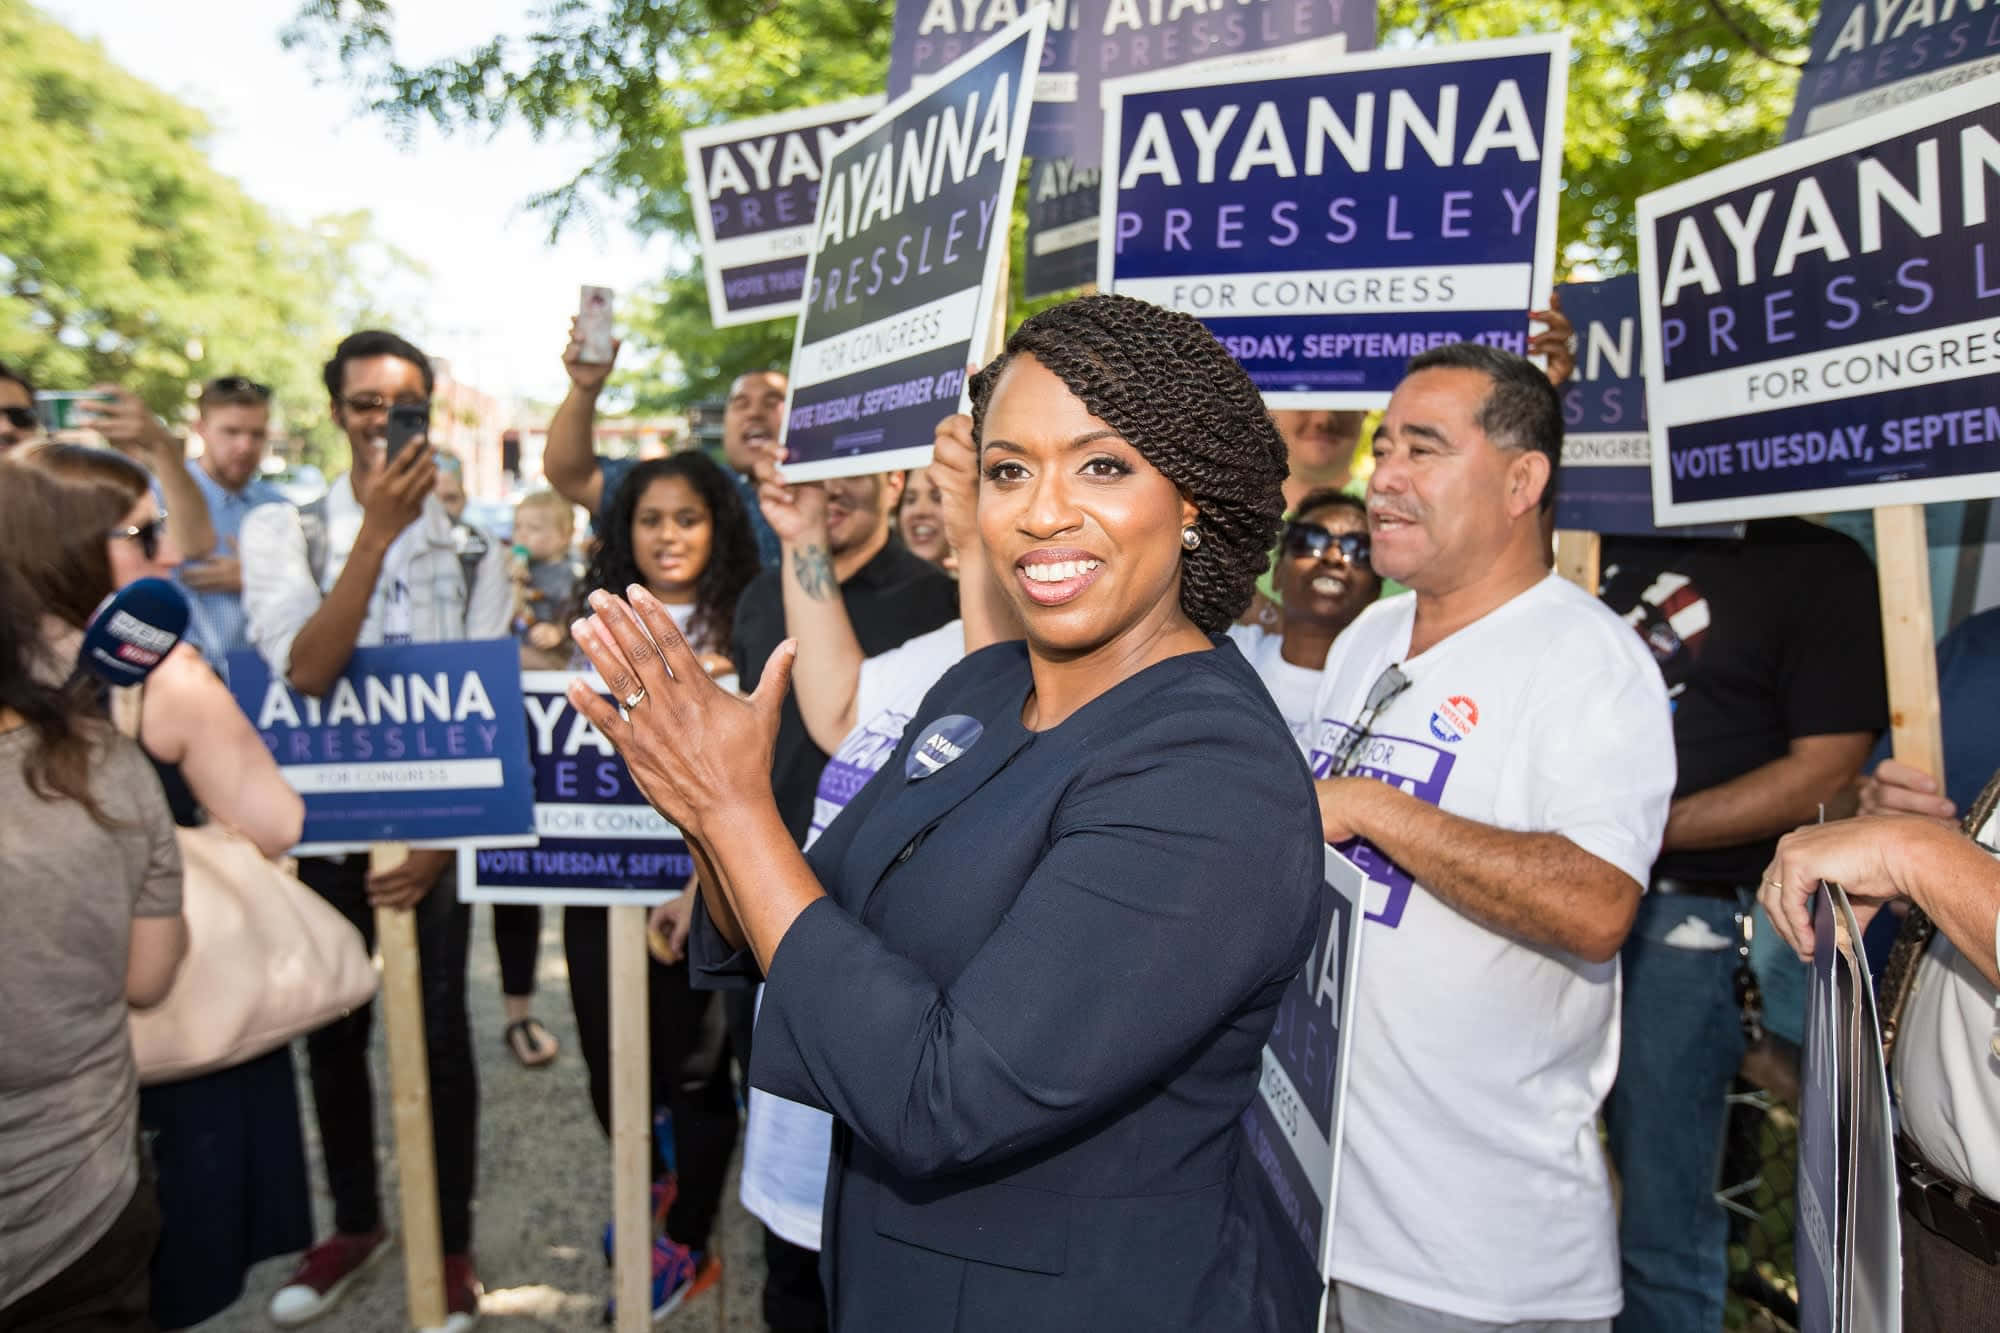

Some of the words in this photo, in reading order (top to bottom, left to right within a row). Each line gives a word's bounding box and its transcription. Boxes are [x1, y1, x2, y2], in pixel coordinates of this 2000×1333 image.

[1824, 0, 2000, 63] AYA
[1119, 79, 1541, 190] AYANNA
[815, 71, 1009, 255] AYANNA
[1114, 187, 1537, 255] PRESSLEY
[803, 193, 999, 314] PRESSLEY
[725, 275, 768, 300] VOTE
[1172, 284, 1237, 310] FOR
[1251, 275, 1457, 306] CONGRESS
[821, 342, 847, 374] FOR
[851, 309, 944, 364] CONGRESS
[1210, 334, 1297, 362] SDAY,
[862, 375, 934, 417] SEPTEMBER
[934, 367, 965, 400] 4TH
[1747, 368, 1809, 401] FOR
[1671, 443, 1733, 481] VOTE
[1736, 424, 1875, 472] TUESDAY,
[258, 670, 497, 730] AYANNA
[262, 724, 498, 761] PRESSLEY
[356, 768, 449, 786] CONGRESS
[478, 850, 529, 874] VOTE
[531, 851, 625, 878] TUESDAY,
